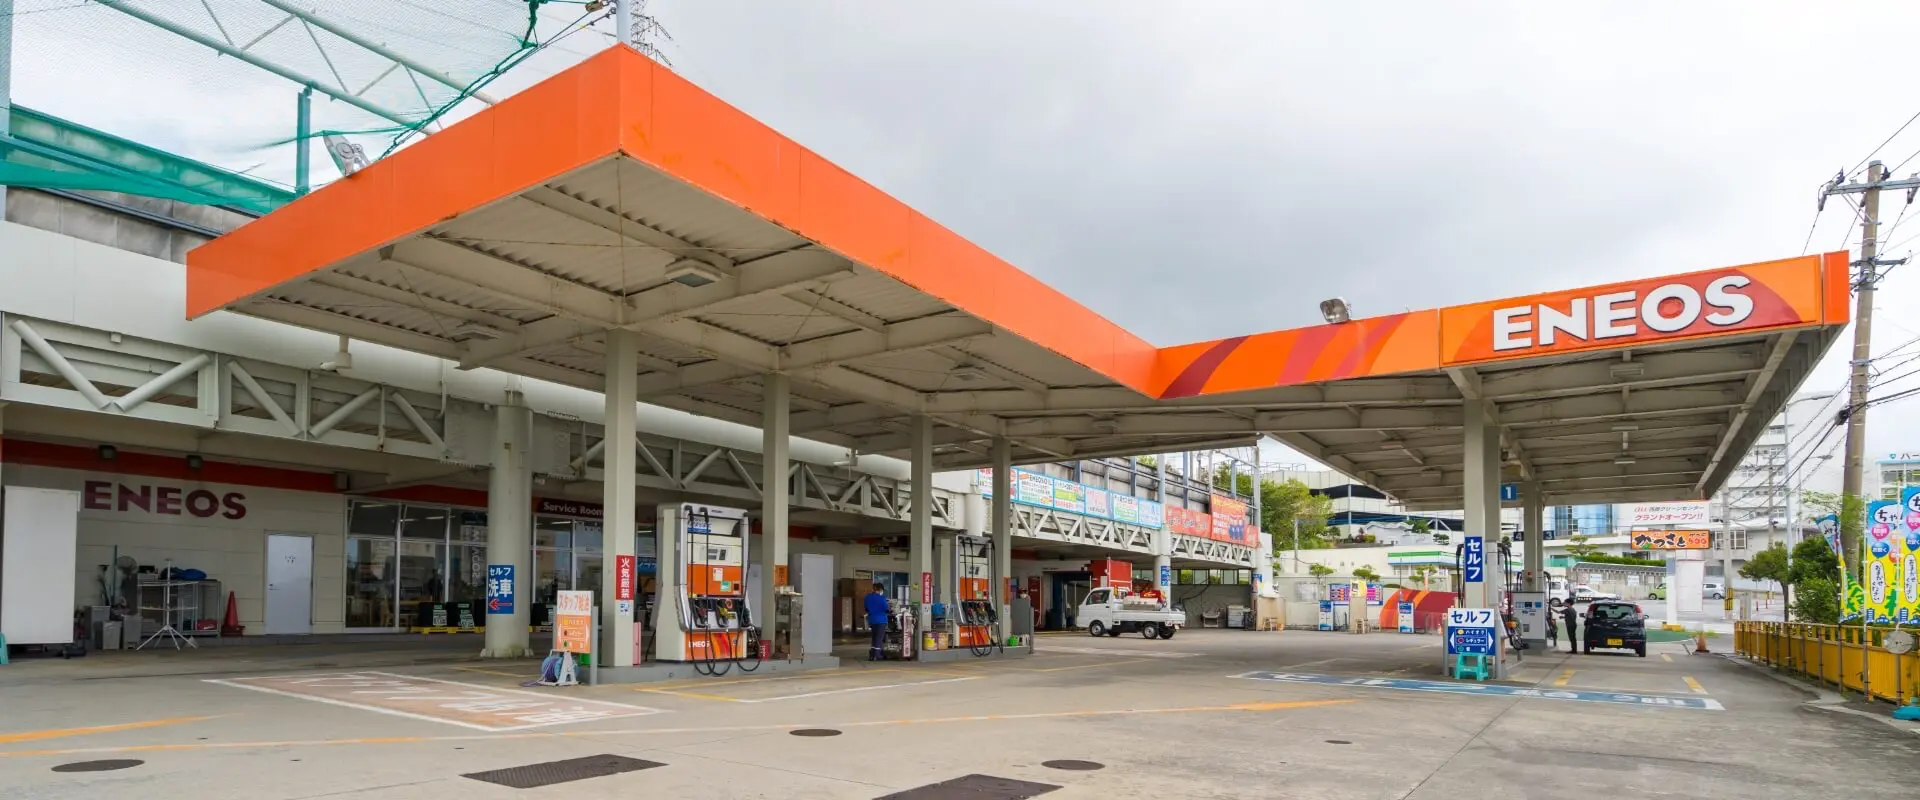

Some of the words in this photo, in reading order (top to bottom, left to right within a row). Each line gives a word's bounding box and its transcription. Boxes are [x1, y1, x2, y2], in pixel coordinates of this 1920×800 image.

[1493, 275, 1754, 351] ENEOS
[84, 480, 247, 520] ENEOS
[1505, 486, 1512, 499] 1
[544, 502, 577, 514] Service
[580, 506, 604, 517] Room
[1467, 538, 1482, 580] セルフ
[489, 567, 511, 577] セルフ
[488, 579, 512, 598] 洗車
[1451, 611, 1491, 624] セルフ
